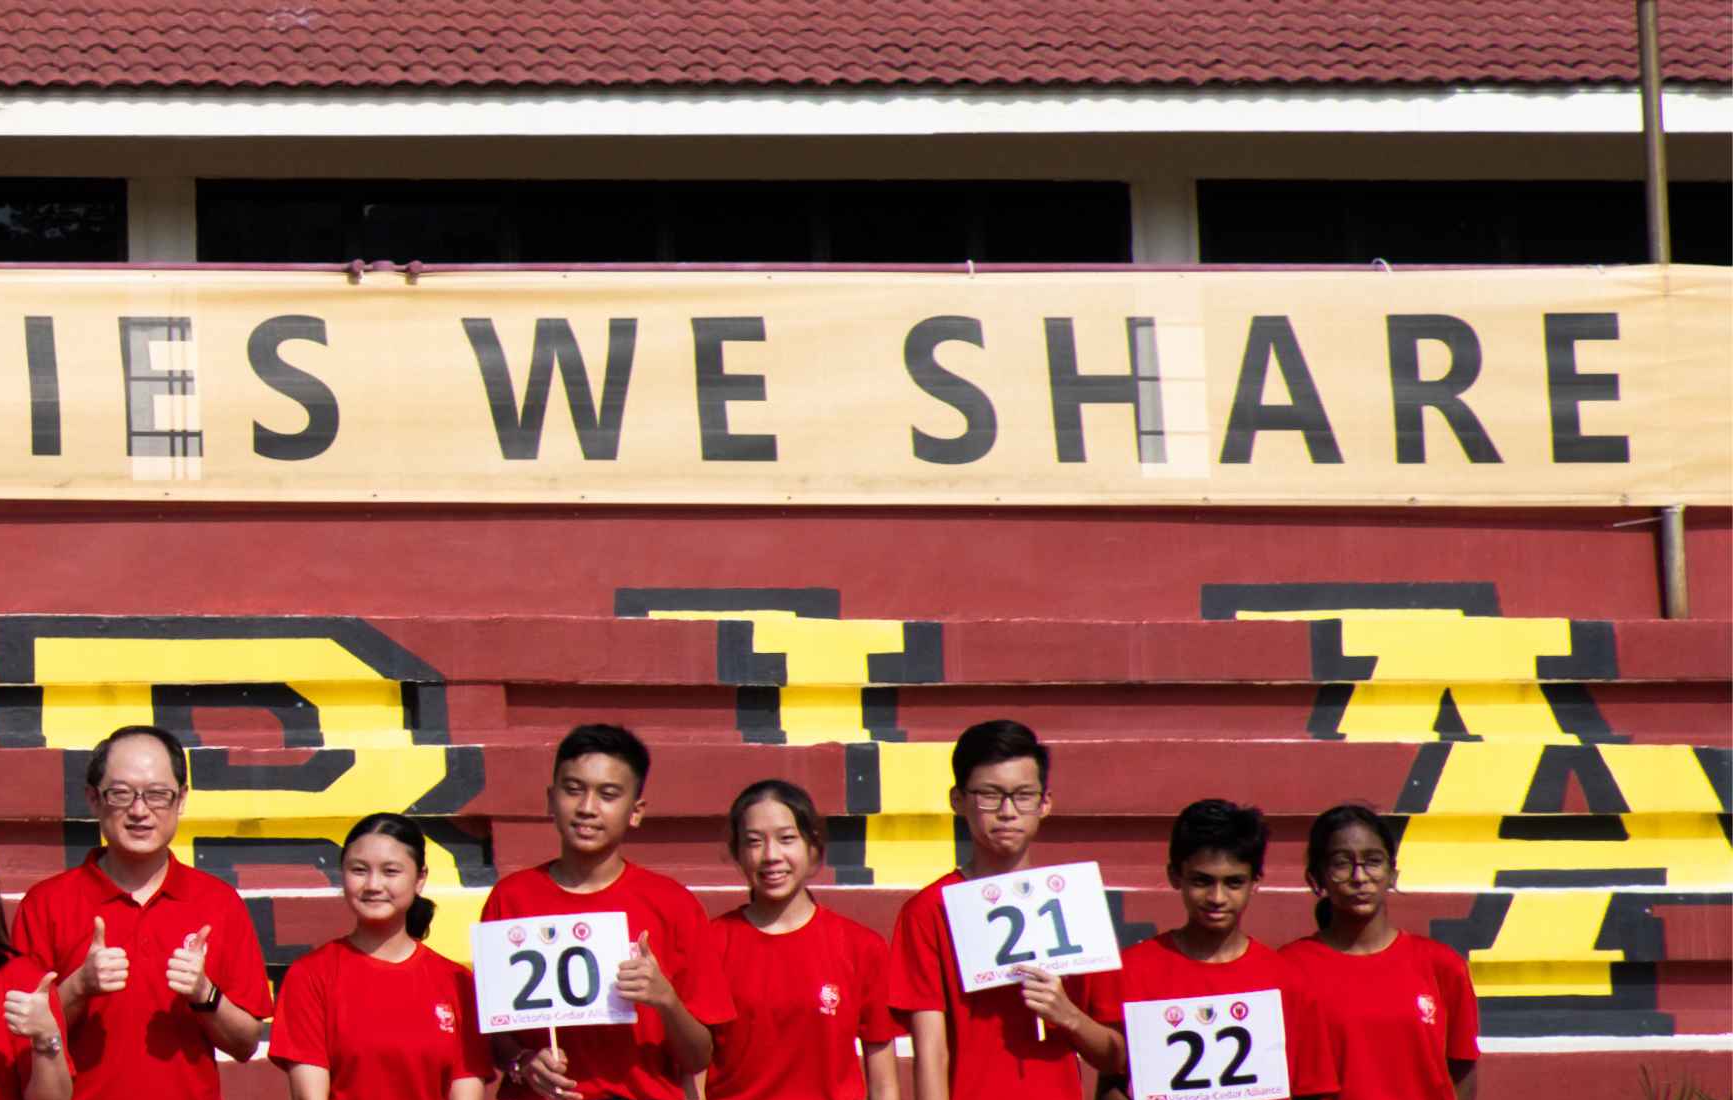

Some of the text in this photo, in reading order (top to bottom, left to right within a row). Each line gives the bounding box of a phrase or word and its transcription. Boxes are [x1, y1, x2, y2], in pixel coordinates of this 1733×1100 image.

[462, 315, 778, 463] WE
[904, 311, 1631, 465] SHARE
[987, 898, 1083, 966] 21
[509, 946, 601, 1011] 20
[1167, 1026, 1258, 1090] 22
